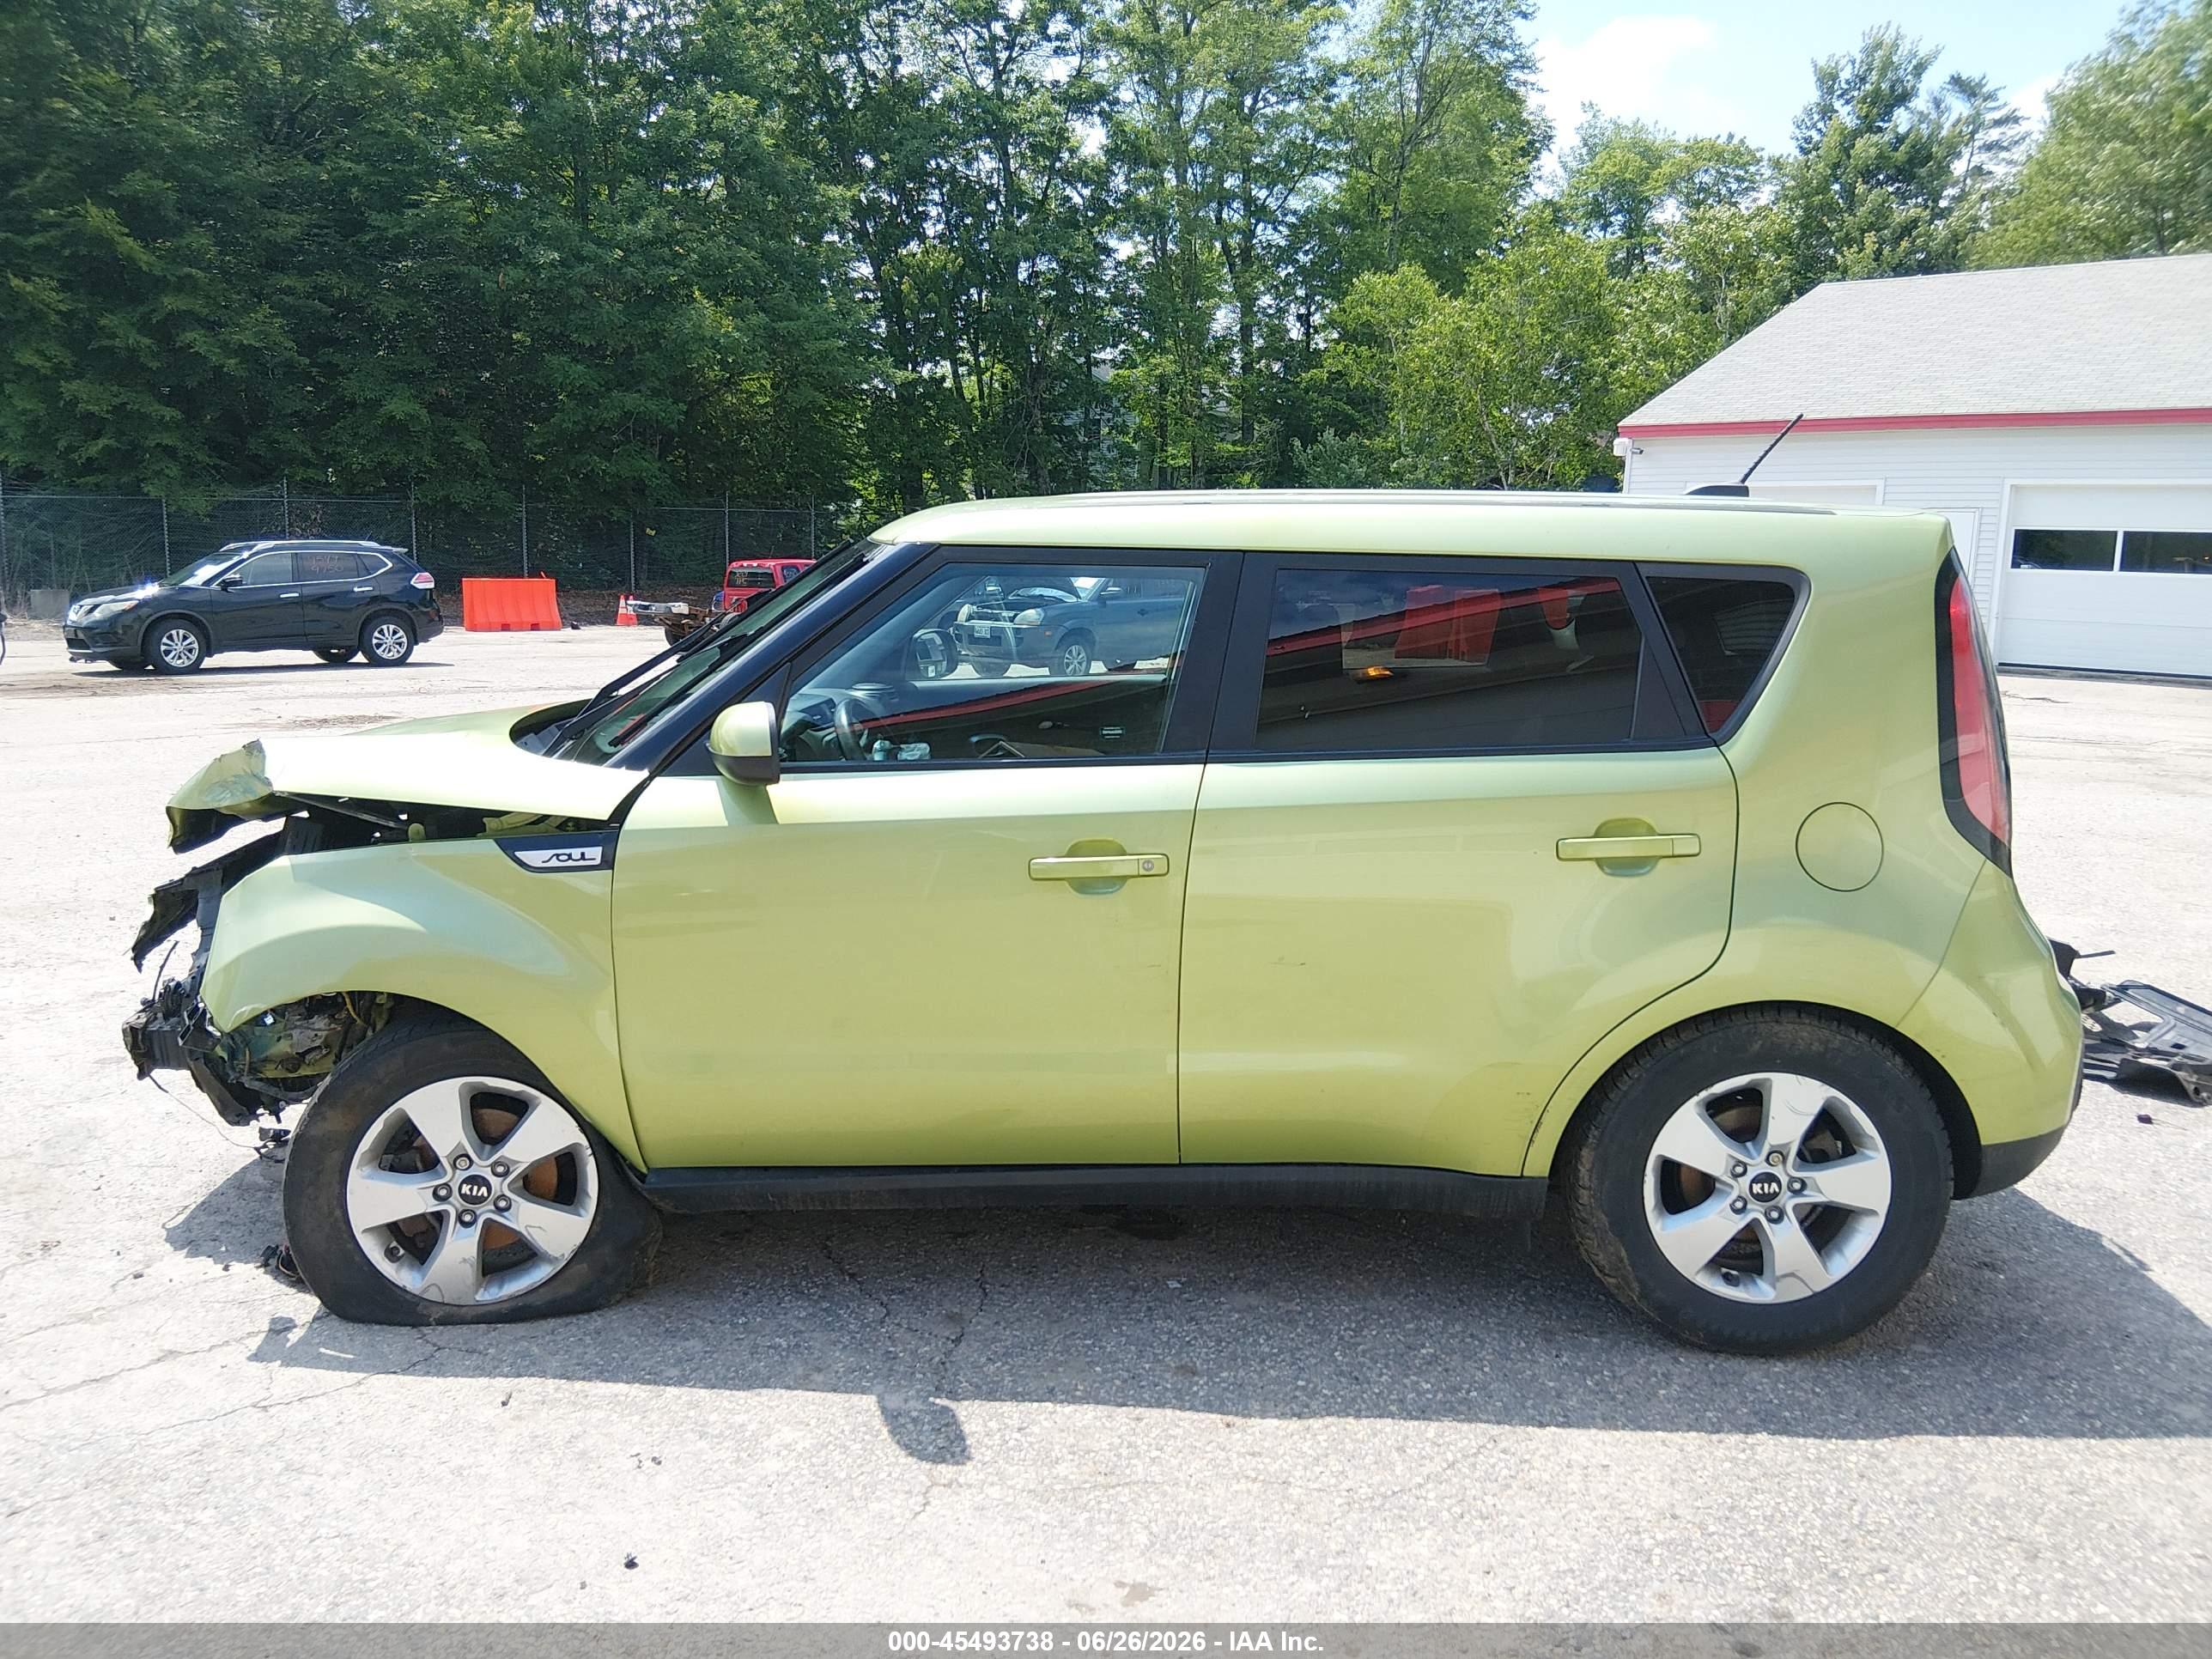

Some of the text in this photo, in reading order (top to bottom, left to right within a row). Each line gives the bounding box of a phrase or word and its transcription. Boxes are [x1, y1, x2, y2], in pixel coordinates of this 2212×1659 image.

[542, 852, 597, 863] SOUL
[460, 1183, 488, 1197] KIA
[1752, 1182, 1779, 1194] KIA
